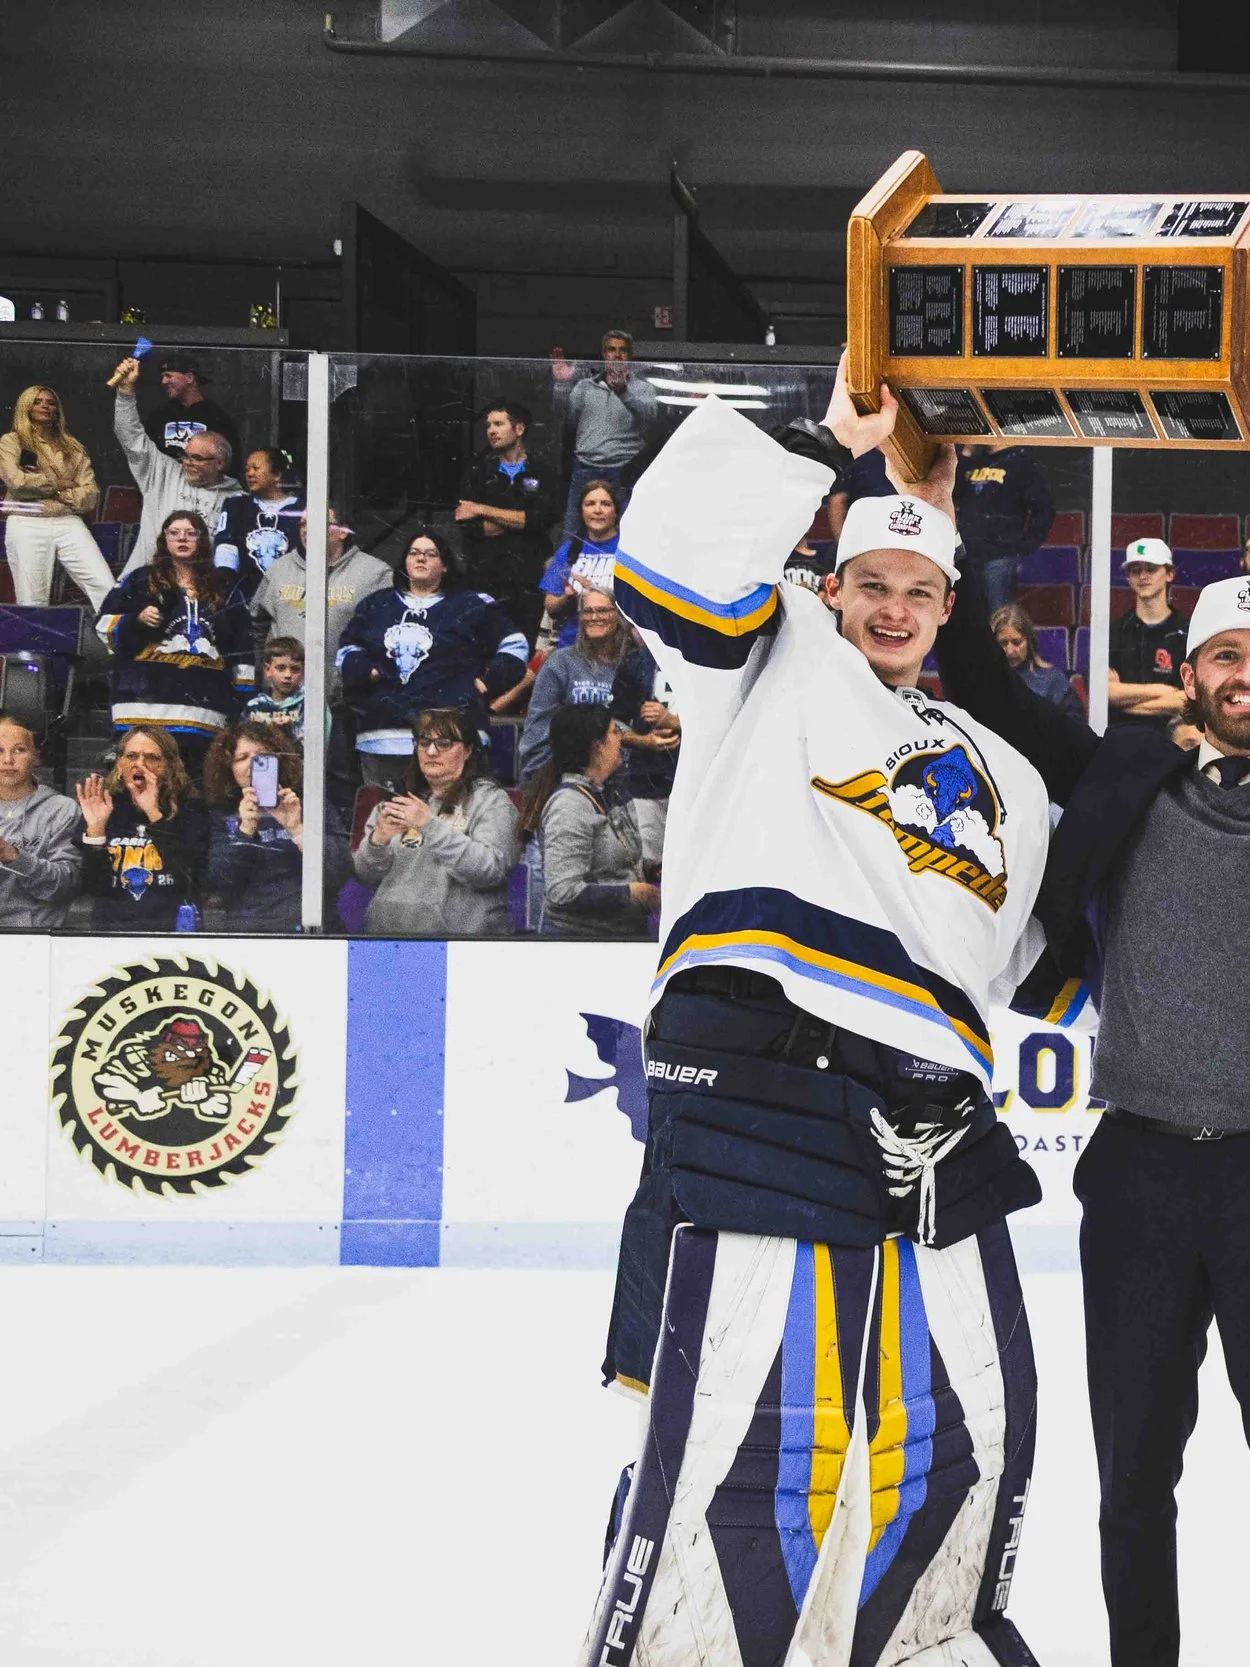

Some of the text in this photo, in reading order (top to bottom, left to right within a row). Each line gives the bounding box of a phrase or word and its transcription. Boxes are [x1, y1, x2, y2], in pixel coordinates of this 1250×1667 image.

[885, 738, 946, 771] SIOUX
[80, 983, 260, 1062] MUSKEGON
[647, 1060, 718, 1087] BAUER
[912, 1072, 948, 1082] PRO
[919, 1062, 954, 1072] BAUER
[86, 1081, 272, 1170] LUMBERJACKS
[1014, 1135, 1092, 1151] OAST
[992, 1477, 1031, 1610] TRUE
